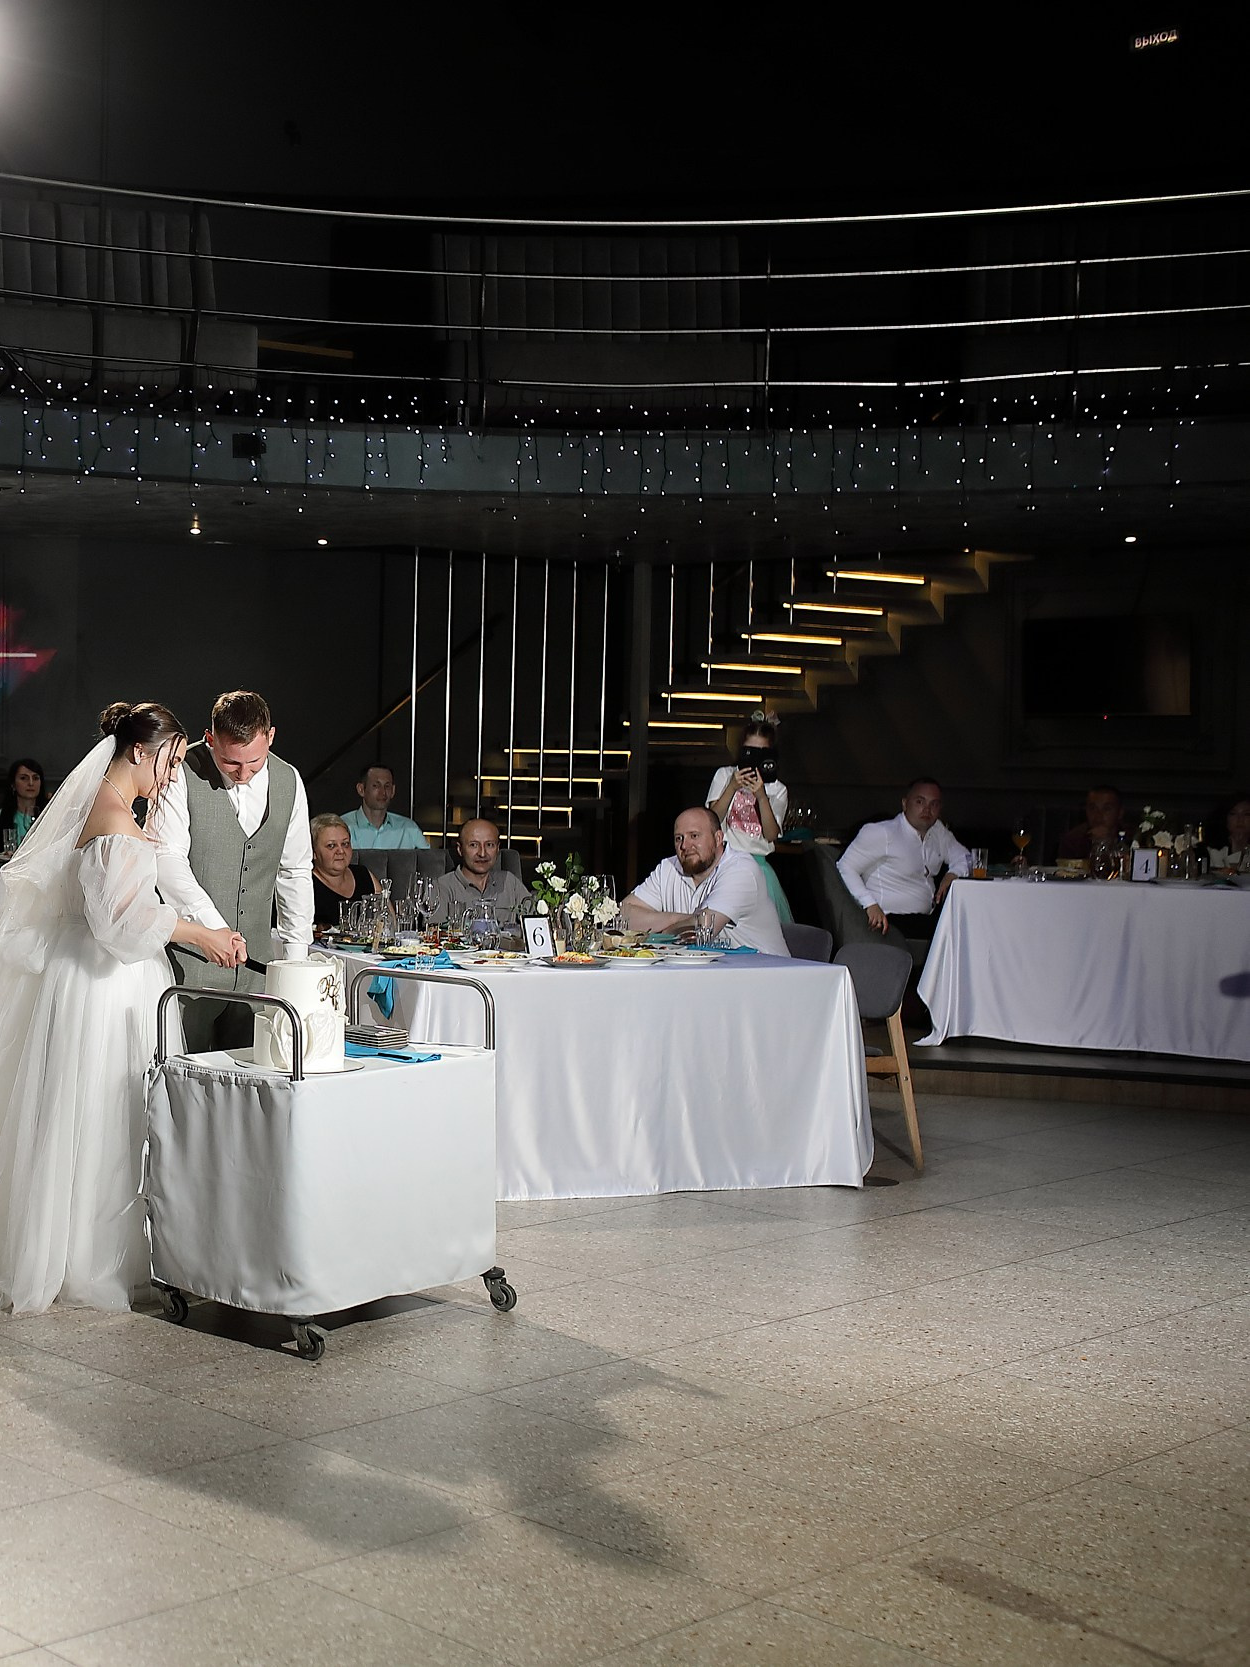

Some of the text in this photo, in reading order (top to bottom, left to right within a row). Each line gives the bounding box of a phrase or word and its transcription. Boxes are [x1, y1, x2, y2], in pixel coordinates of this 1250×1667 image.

[1134, 29, 1178, 49] ВЫХОД
[1139, 858, 1151, 874] 4
[532, 926, 545, 947] 6
